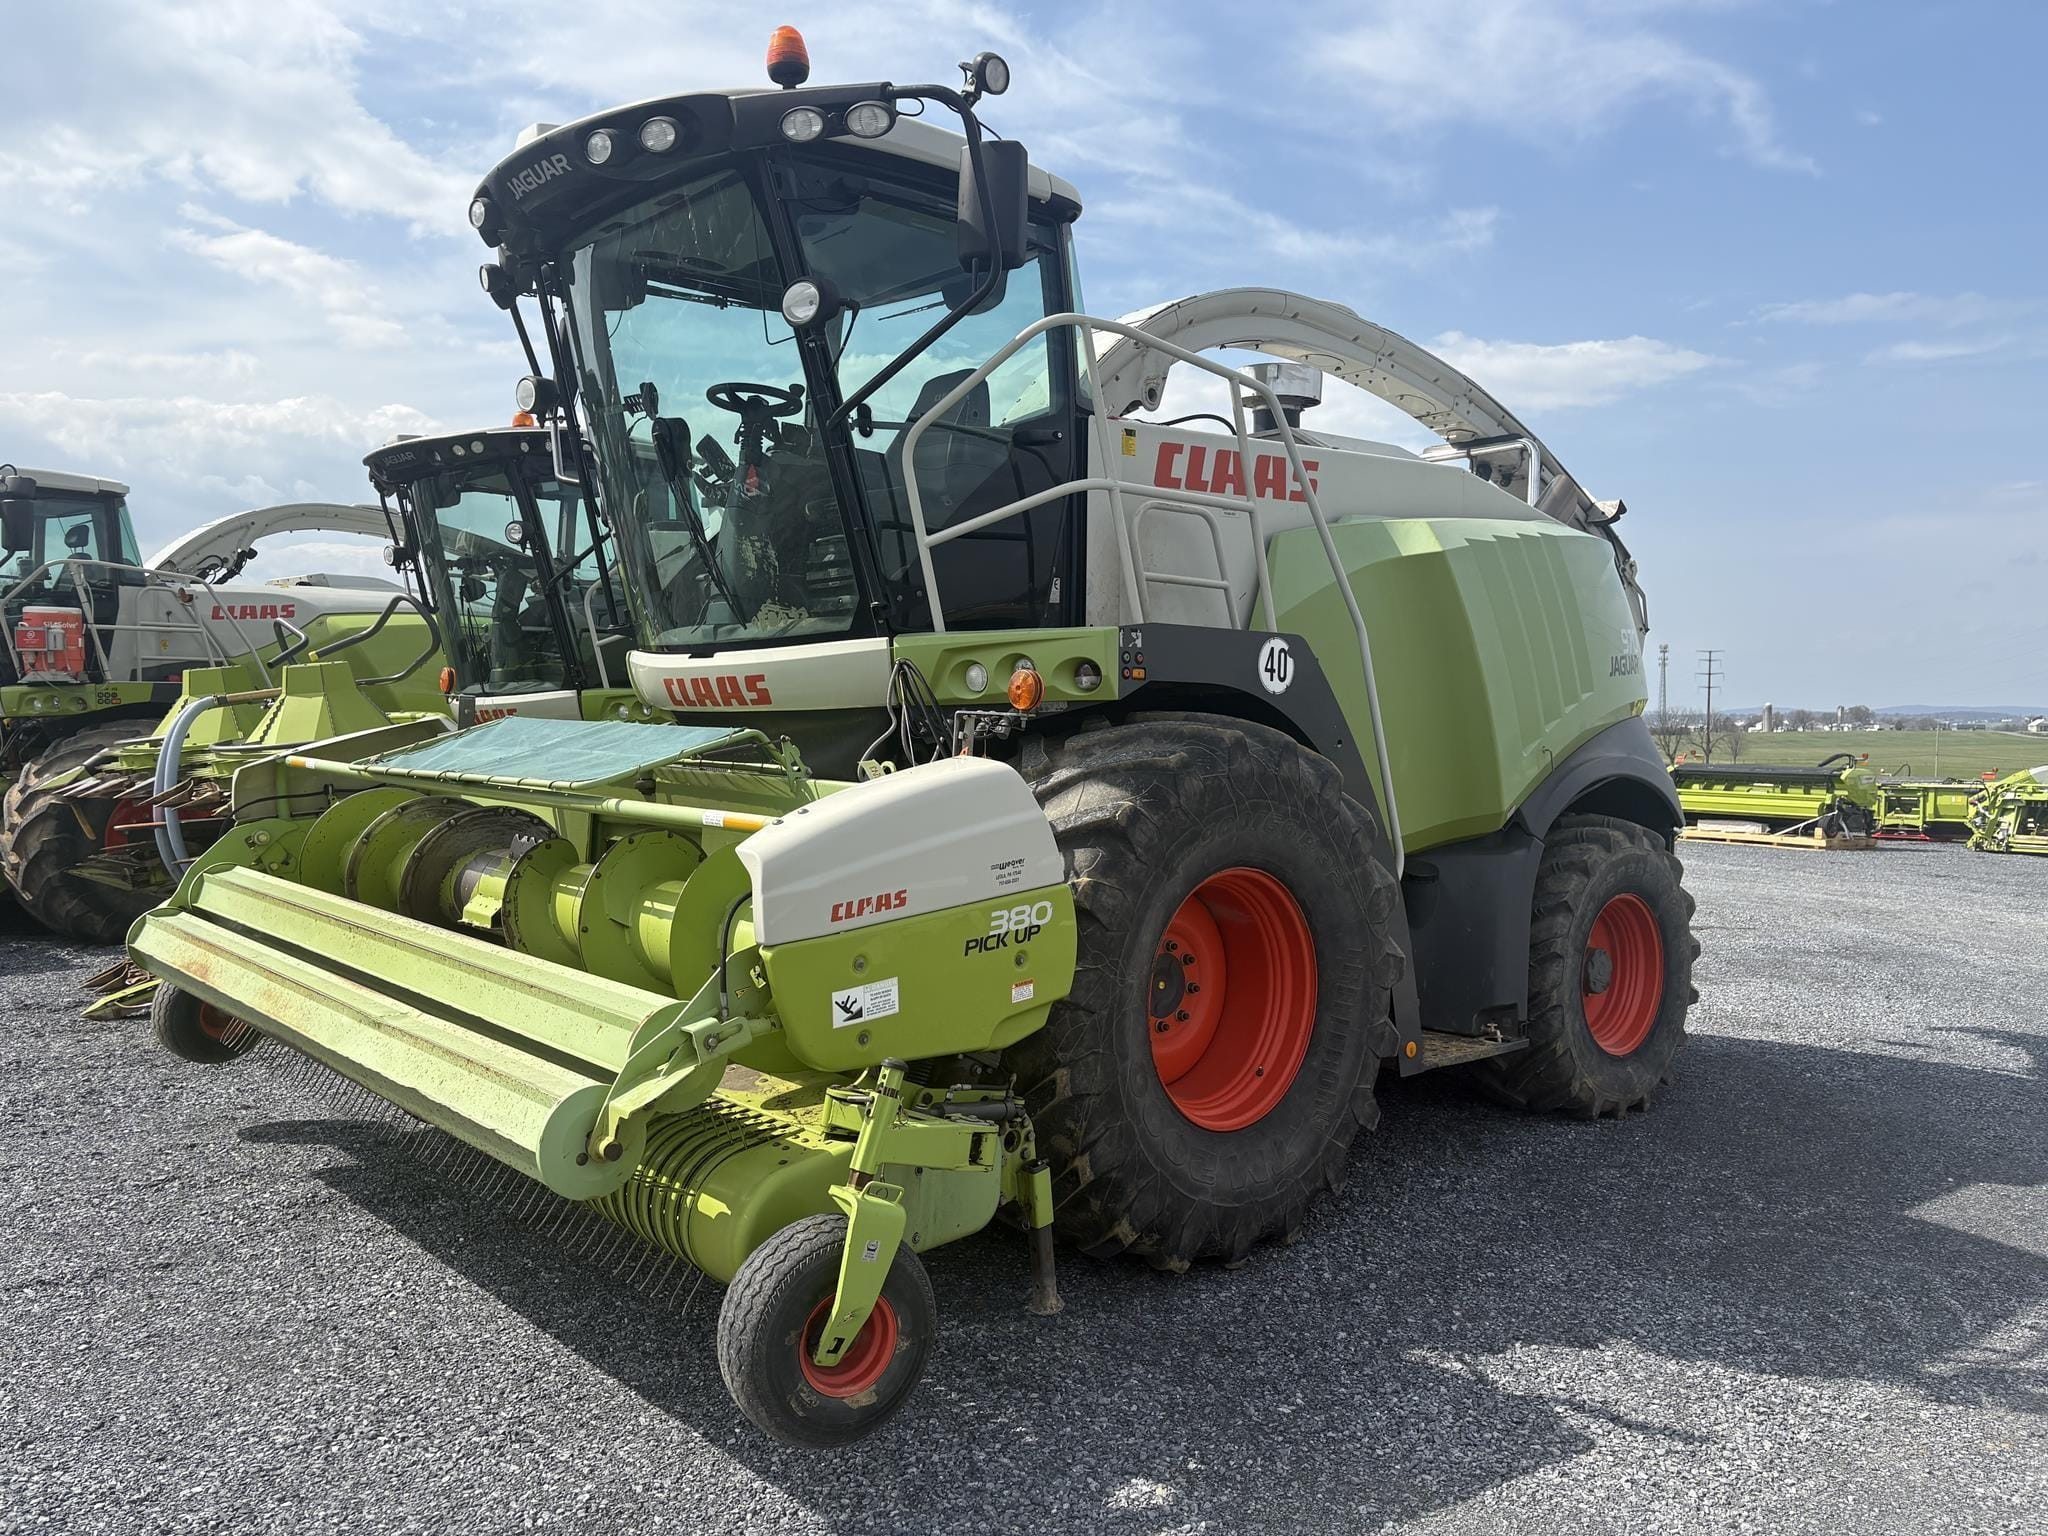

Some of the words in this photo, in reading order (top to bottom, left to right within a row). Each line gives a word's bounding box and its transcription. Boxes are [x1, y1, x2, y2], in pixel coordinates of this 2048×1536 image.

[506, 153, 573, 200] JAGUAR
[1154, 441, 1319, 503] CLAAS
[211, 604, 296, 620] CLAAS
[1264, 646, 1288, 683] 40
[663, 674, 773, 707] CLAAS
[830, 889, 908, 922] CLAAS
[989, 900, 1053, 935] 380
[964, 931, 1008, 956] PICK
[1014, 924, 1042, 944] UP
